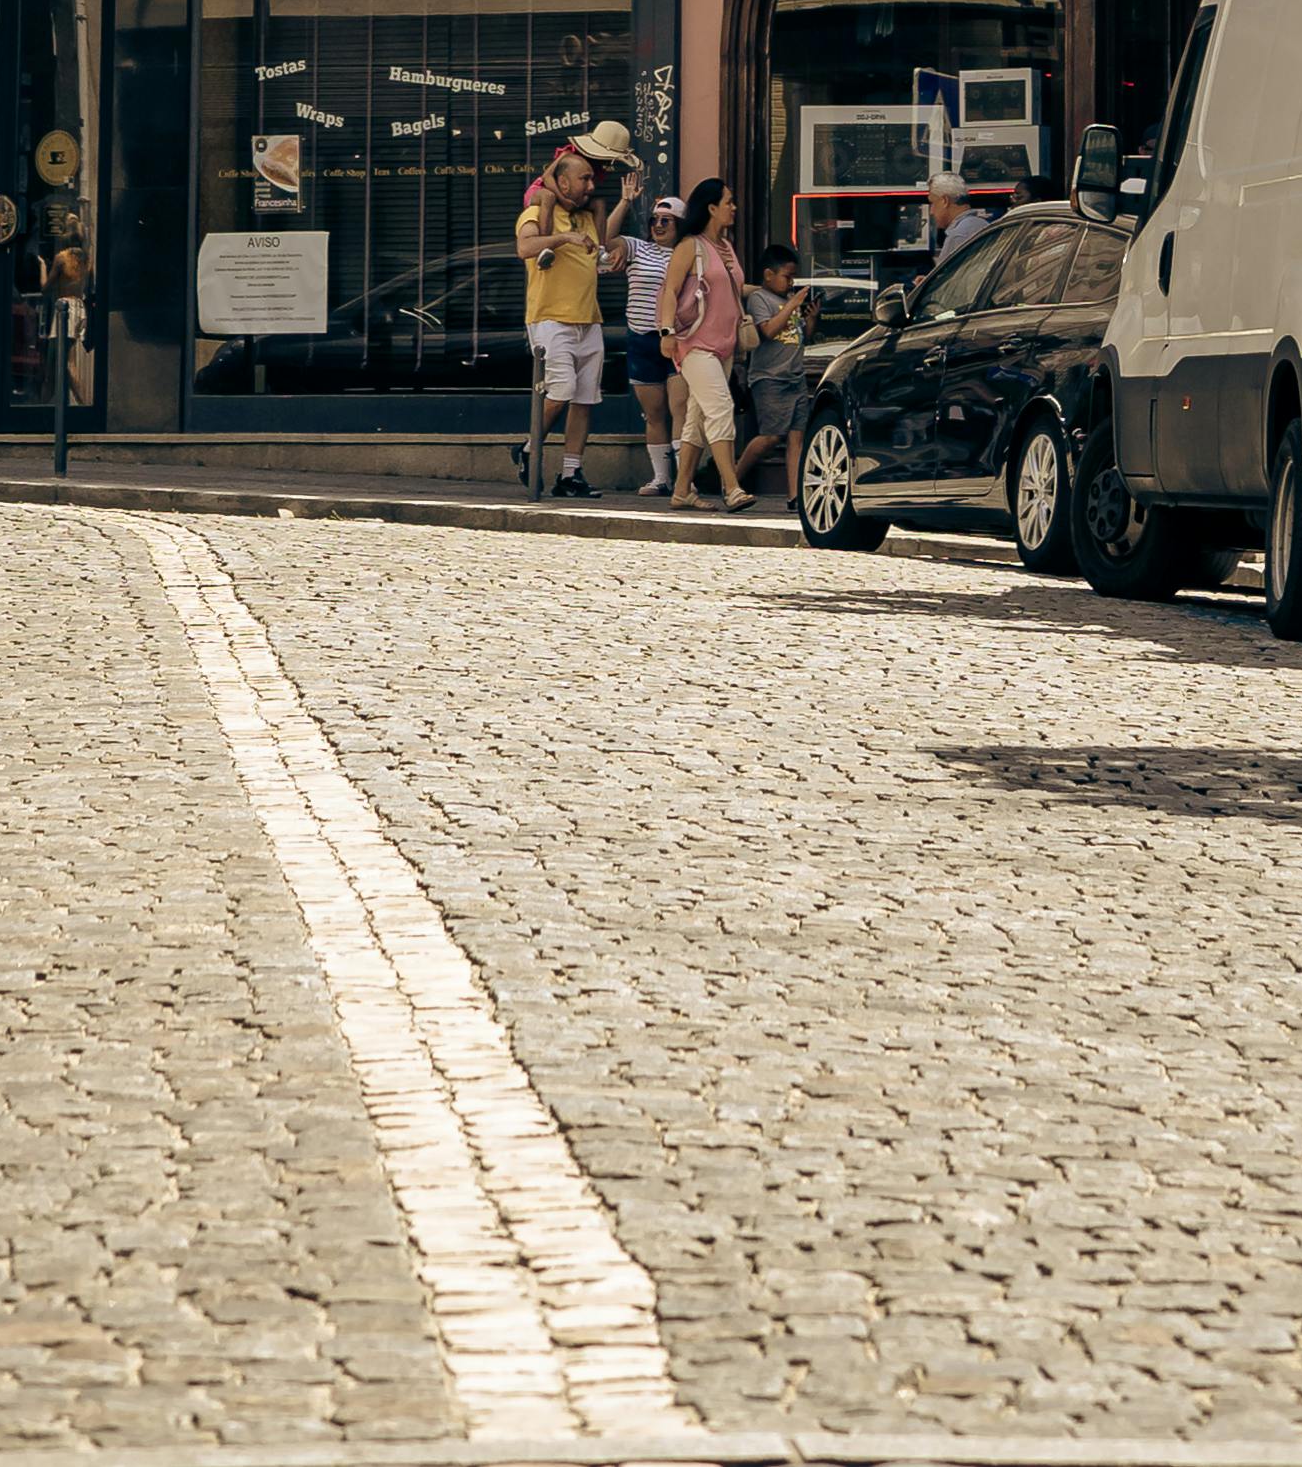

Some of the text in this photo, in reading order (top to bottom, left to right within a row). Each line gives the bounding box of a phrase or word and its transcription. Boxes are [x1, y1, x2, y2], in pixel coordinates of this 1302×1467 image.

[255, 59, 307, 81] Tostas
[389, 66, 506, 95] Hamburgueres
[295, 102, 345, 129] Wraps
[391, 113, 445, 137] Bagels
[525, 111, 591, 136] Saladas
[247, 237, 281, 248] AVISO
